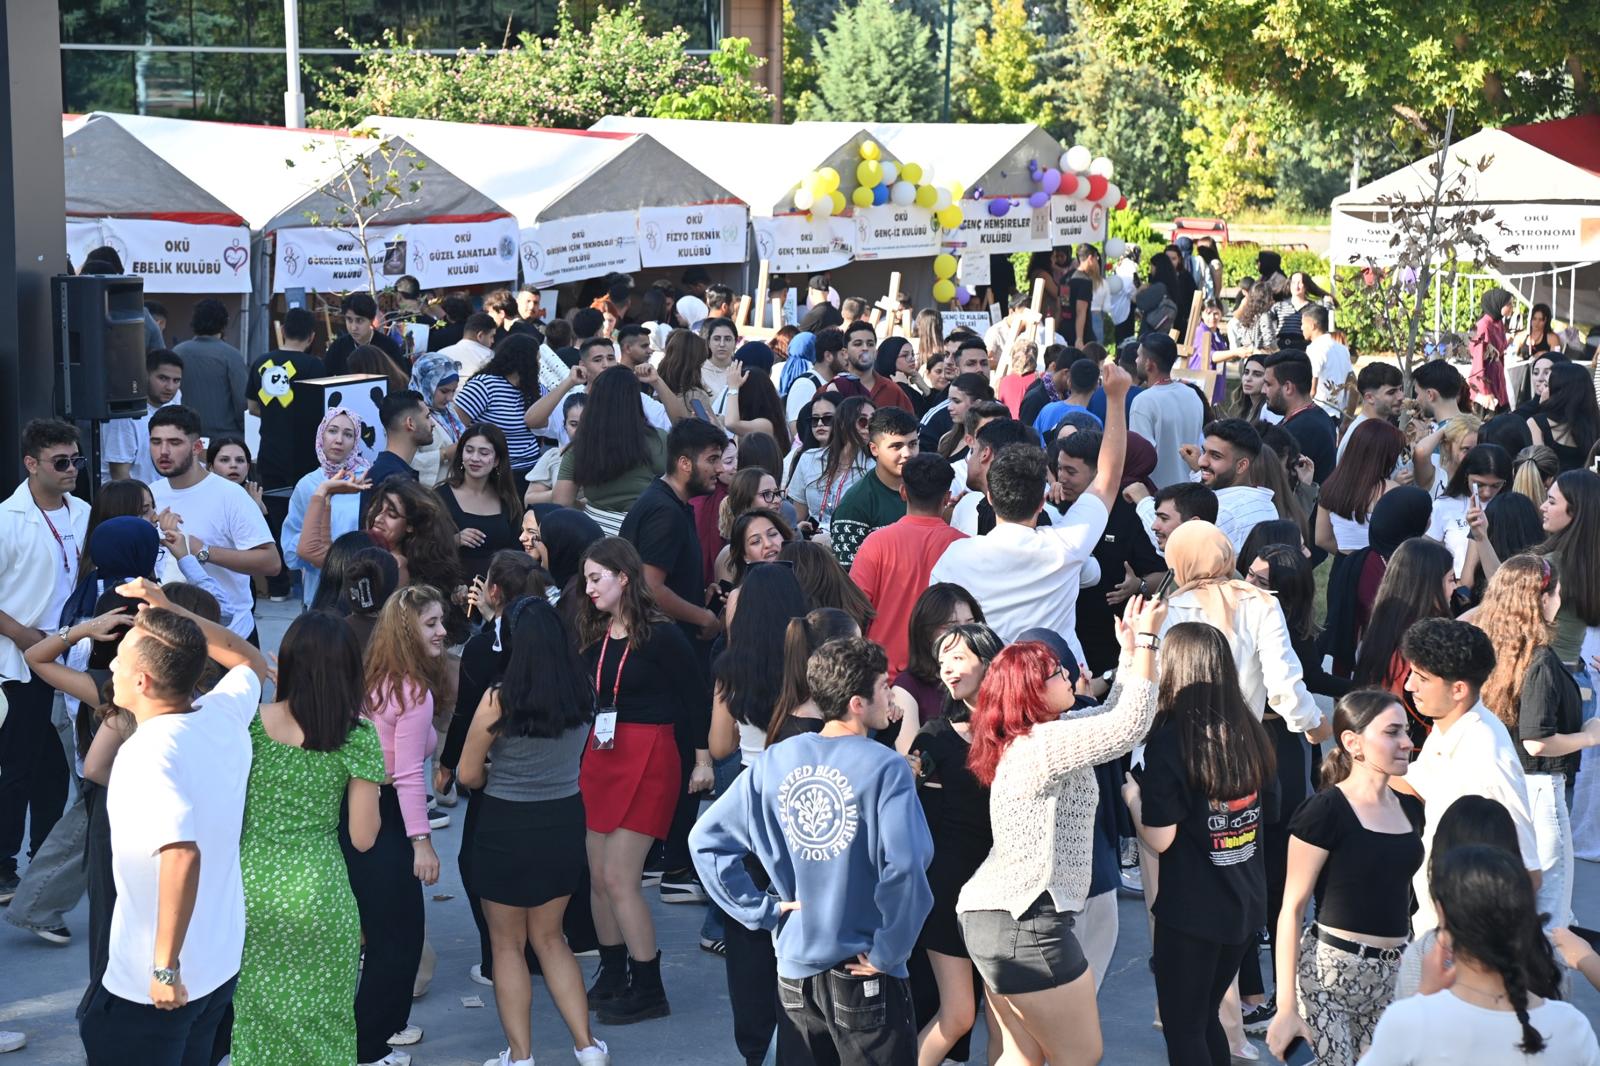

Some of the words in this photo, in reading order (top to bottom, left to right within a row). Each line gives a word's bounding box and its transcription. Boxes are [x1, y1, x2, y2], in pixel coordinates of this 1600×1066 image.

[686, 212, 703, 224] OKÜ
[894, 210, 908, 221] OKÜ
[984, 217, 1031, 230] HEMŞİRELER
[666, 230, 689, 242] FİZYO
[691, 228, 721, 240] TEKNİK
[902, 224, 927, 236] KULÜBÜ
[454, 231, 472, 243] OKÜ
[980, 231, 1012, 243] KULÜBÜ
[165, 237, 190, 252] OKÜ
[429, 249, 455, 261] GÜZEL
[457, 247, 497, 259] SANATLAR
[678, 245, 711, 257] KULÜBÜ
[778, 247, 795, 257] GENÇ
[132, 259, 172, 274] EBELİK
[176, 259, 221, 275] KULÜBÜ
[448, 263, 479, 275] KULÜBÜ
[333, 270, 362, 279] KULÜBÜ
[815, 765, 854, 800] BLOOM
[777, 765, 813, 822] PLANTED
[830, 804, 858, 857] WHERE
[800, 848, 831, 860] YOU
